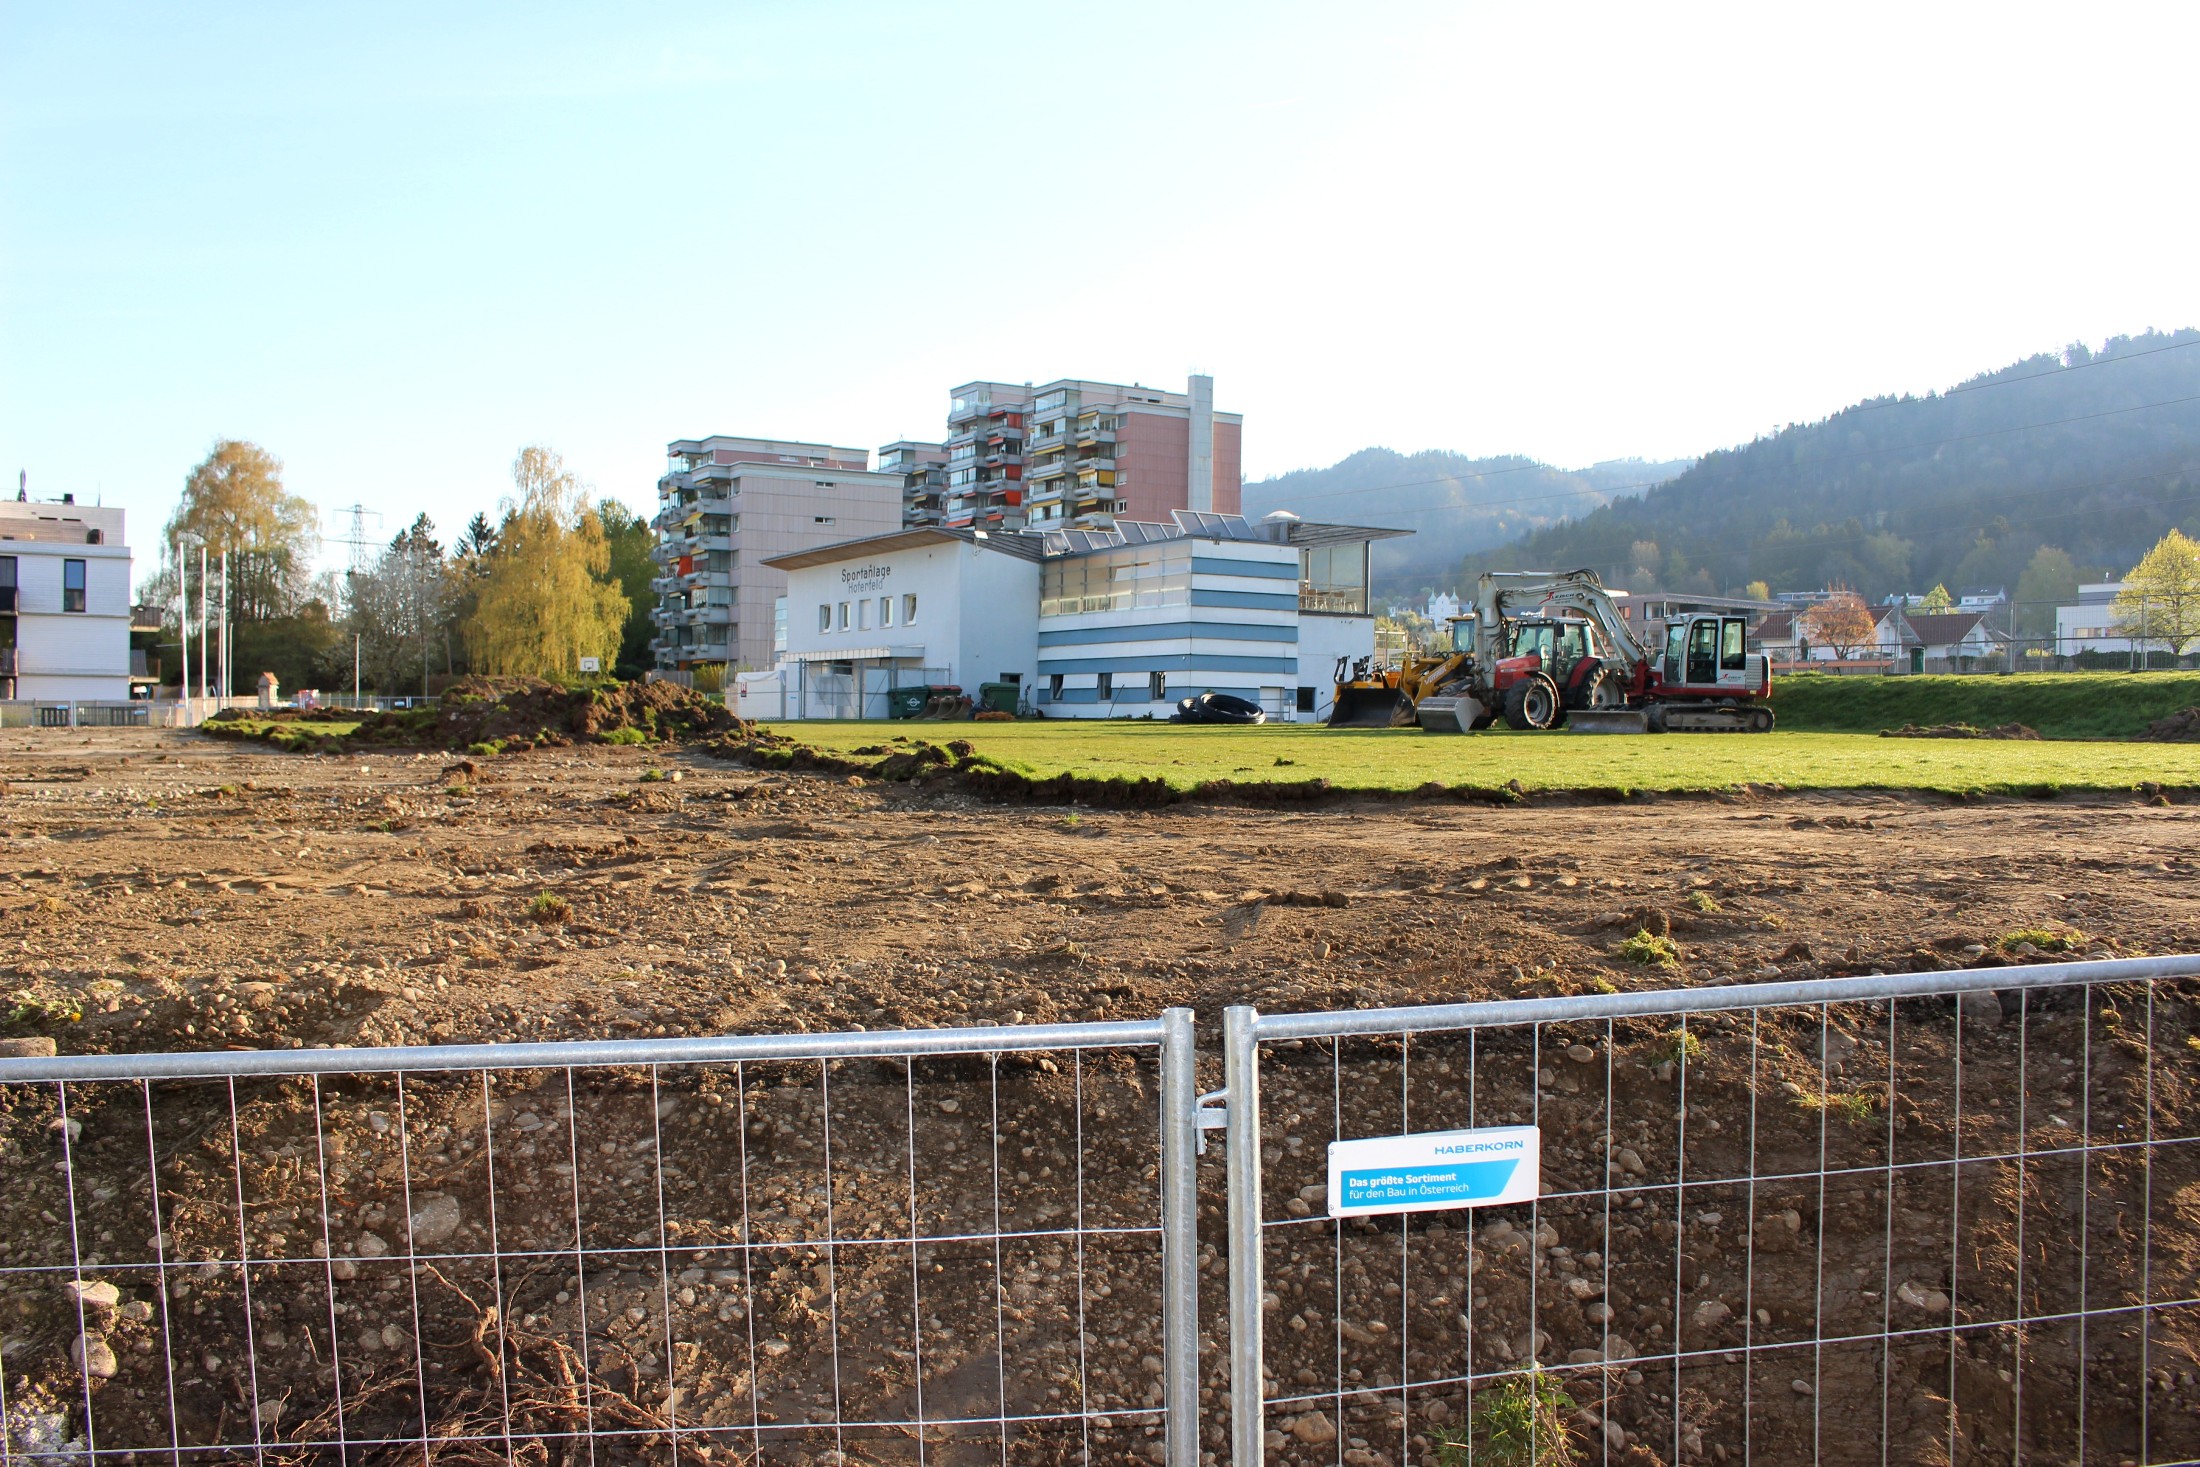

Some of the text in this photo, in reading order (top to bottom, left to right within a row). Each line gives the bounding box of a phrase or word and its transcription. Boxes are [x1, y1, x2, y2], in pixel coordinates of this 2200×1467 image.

[841, 564, 891, 584] Sportanlage
[848, 578, 883, 594] Hoferfeld
[1434, 1140, 1524, 1155] HABERKORN
[1349, 1172, 1457, 1189] Das größte Sortiment
[1349, 1183, 1469, 1199] für den Bau in Österreich
